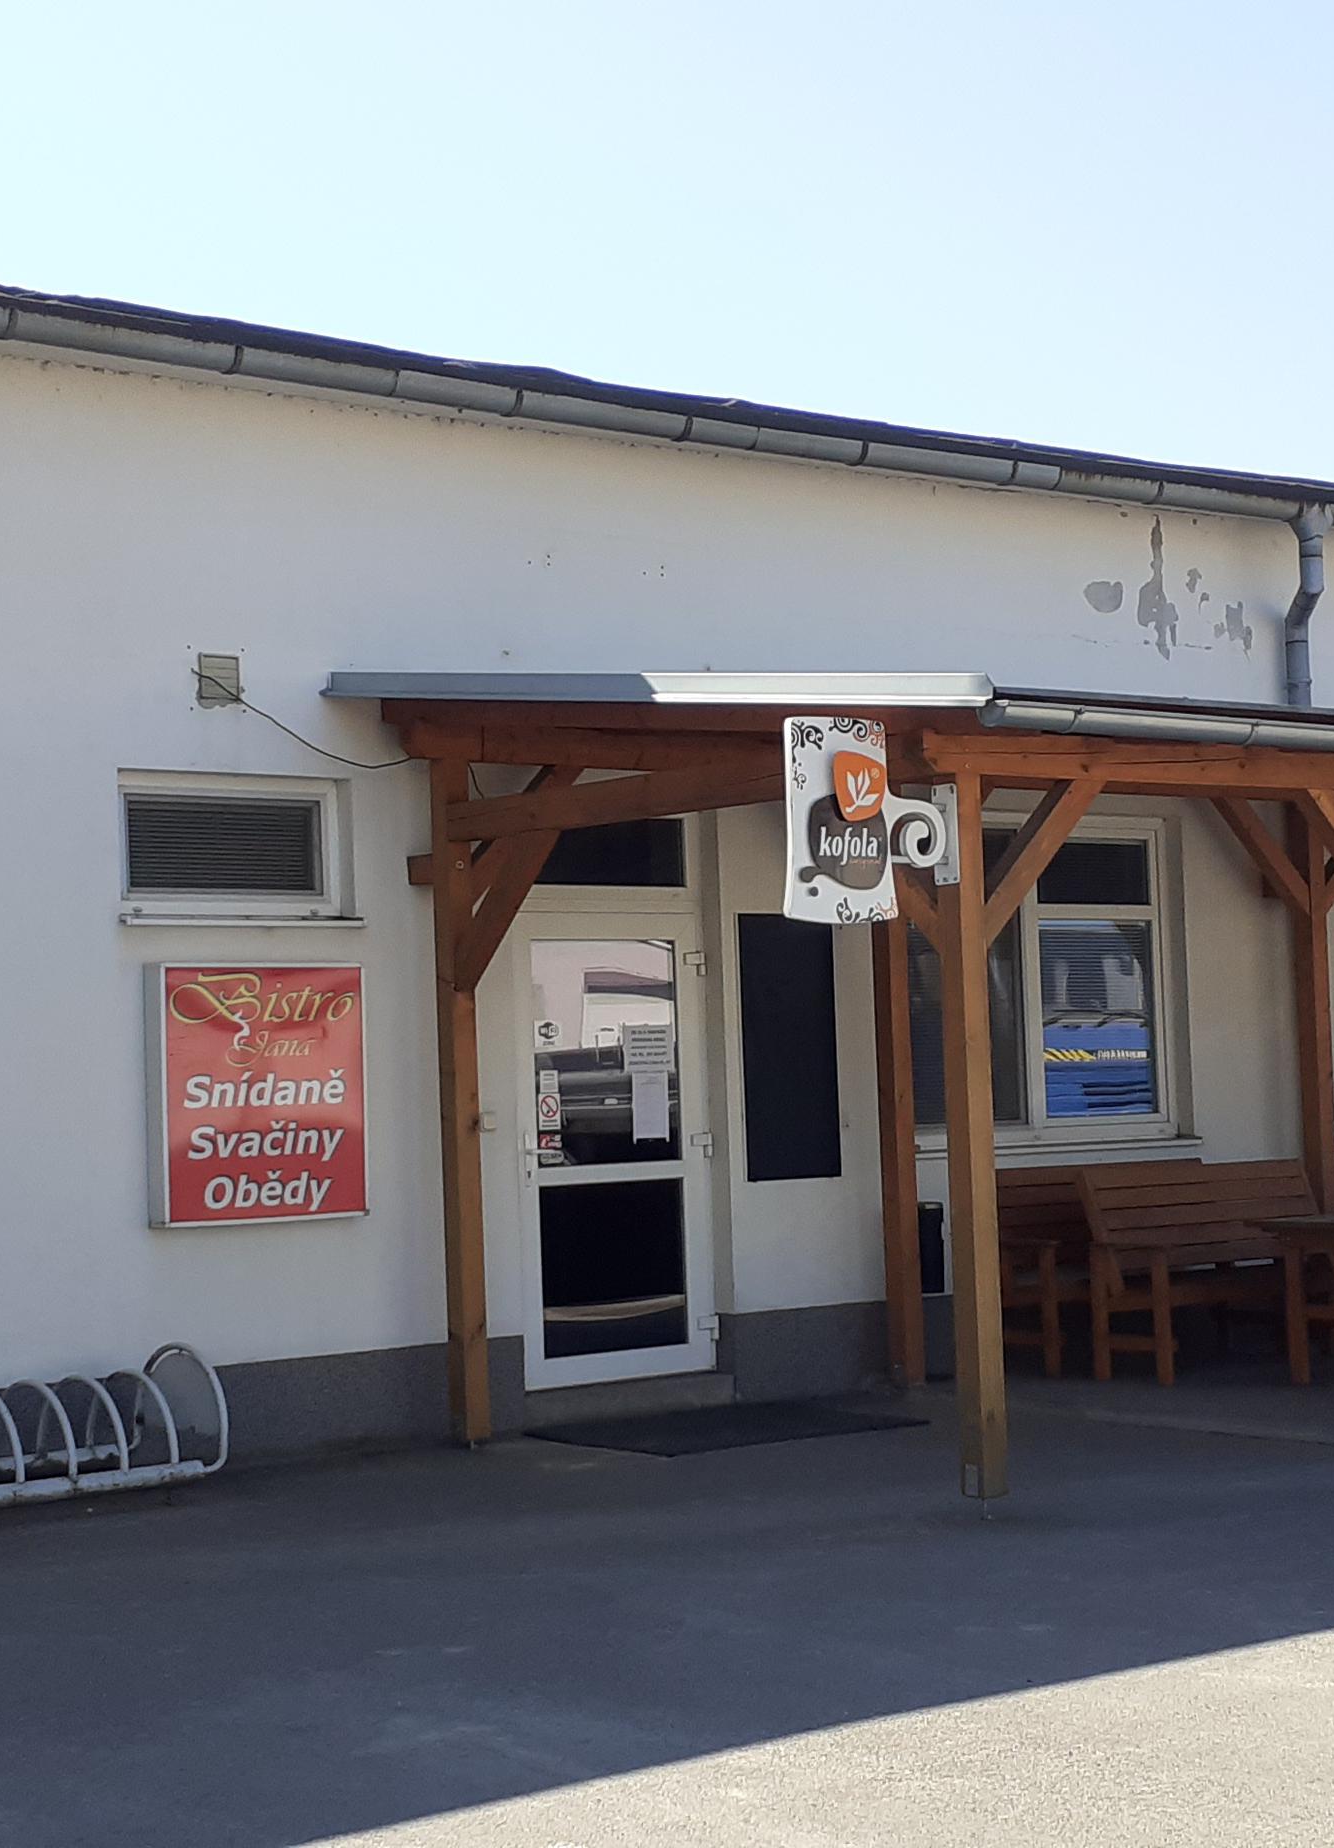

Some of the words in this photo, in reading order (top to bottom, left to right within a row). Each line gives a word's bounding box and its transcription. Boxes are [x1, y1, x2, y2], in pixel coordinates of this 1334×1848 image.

[819, 826, 878, 866] kofola
[170, 972, 355, 1024] Bistro
[226, 1030, 316, 1067] Jana
[184, 1069, 346, 1109] Snídaně
[188, 1120, 345, 1161] Svačiny
[204, 1170, 333, 1211] Obědy
